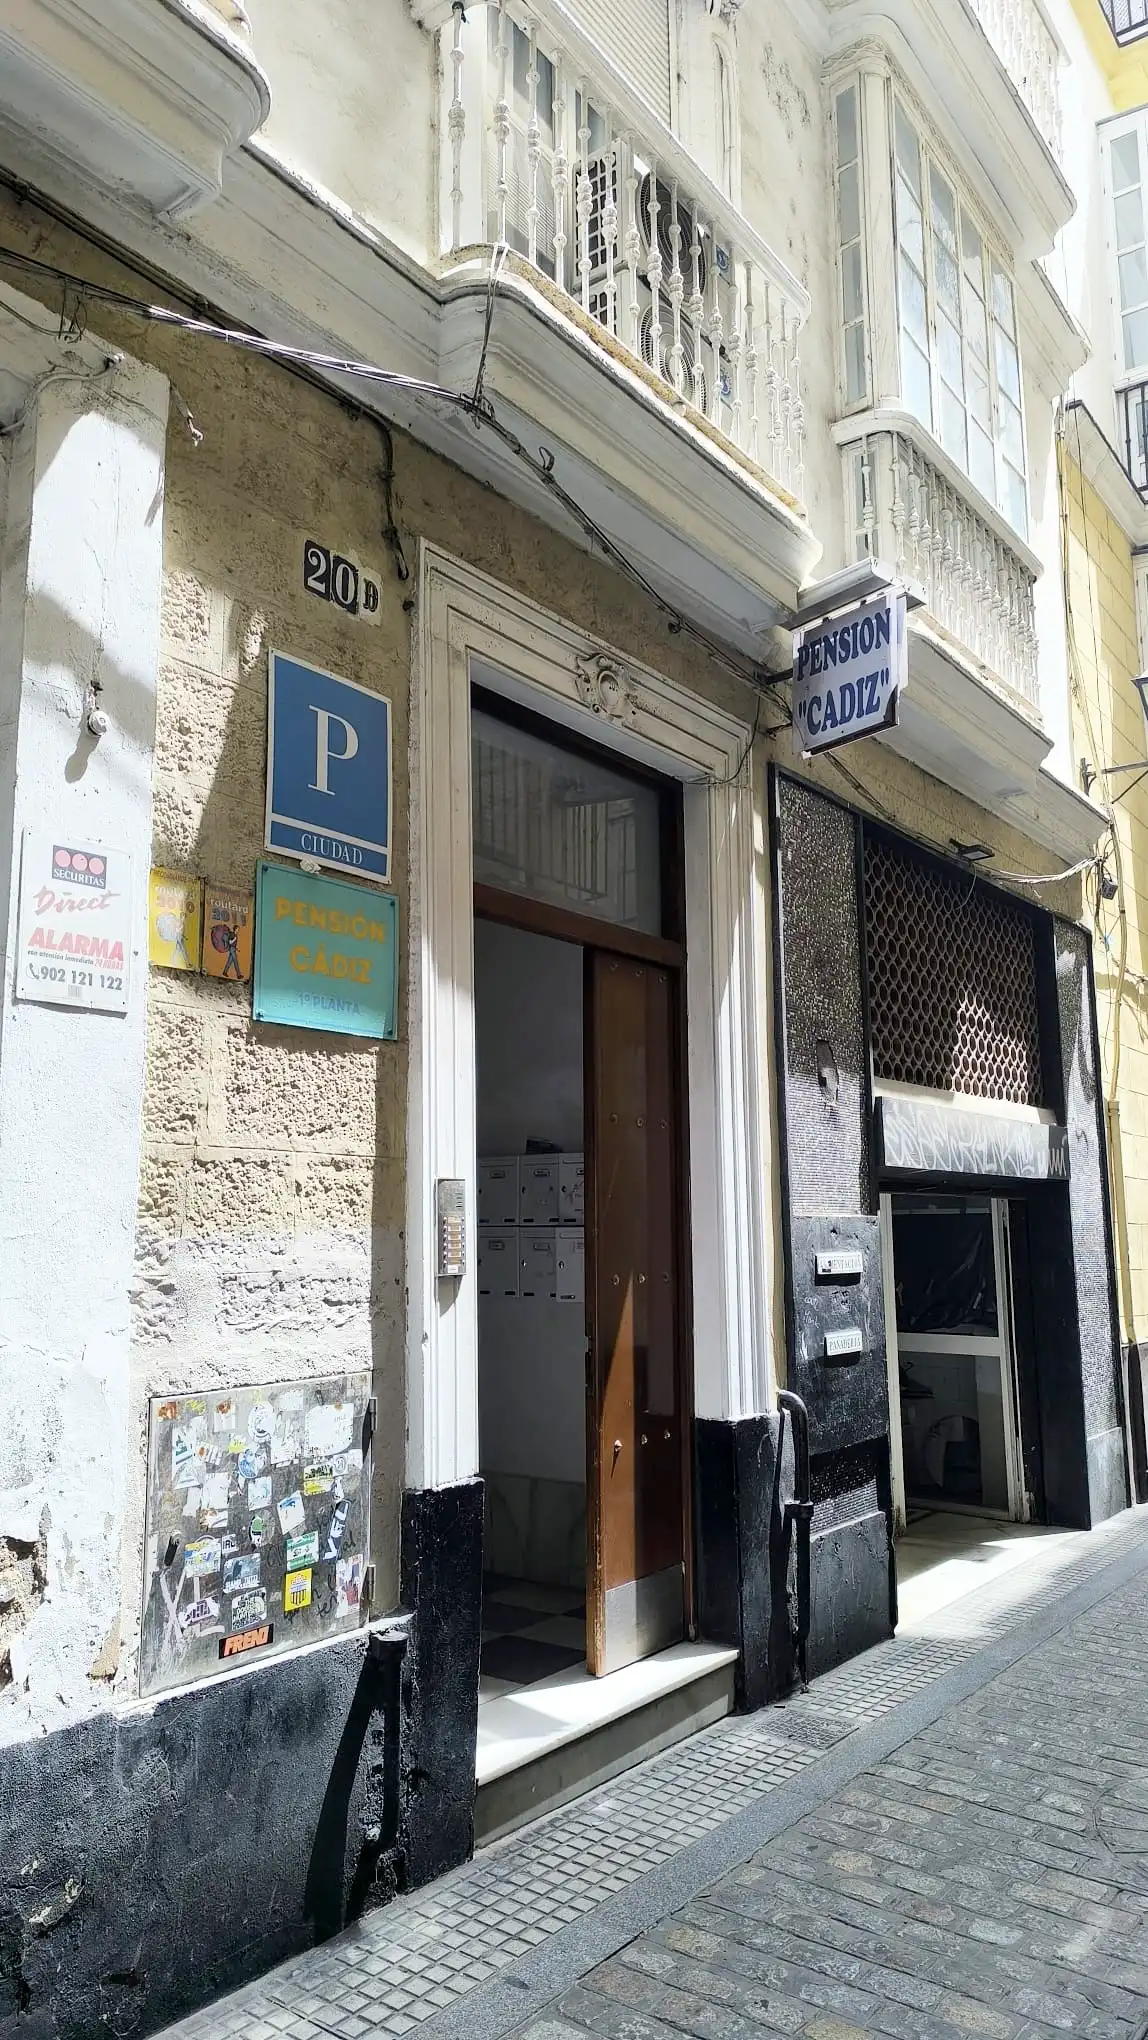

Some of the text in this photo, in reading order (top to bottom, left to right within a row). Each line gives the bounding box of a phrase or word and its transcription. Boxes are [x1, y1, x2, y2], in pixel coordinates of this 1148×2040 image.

[797, 607, 891, 682] PENSION
[306, 703, 359, 797] P
[301, 833, 363, 865] CIUDAD
[53, 868, 105, 888] SECURITAS
[33, 885, 121, 915] Direct
[274, 895, 386, 945] PENSIÓN
[27, 927, 124, 961] ALARMA
[40, 965, 123, 991] 902 121 122
[289, 943, 373, 985] CÁDIZ
[312, 994, 361, 1016] PLANTA
